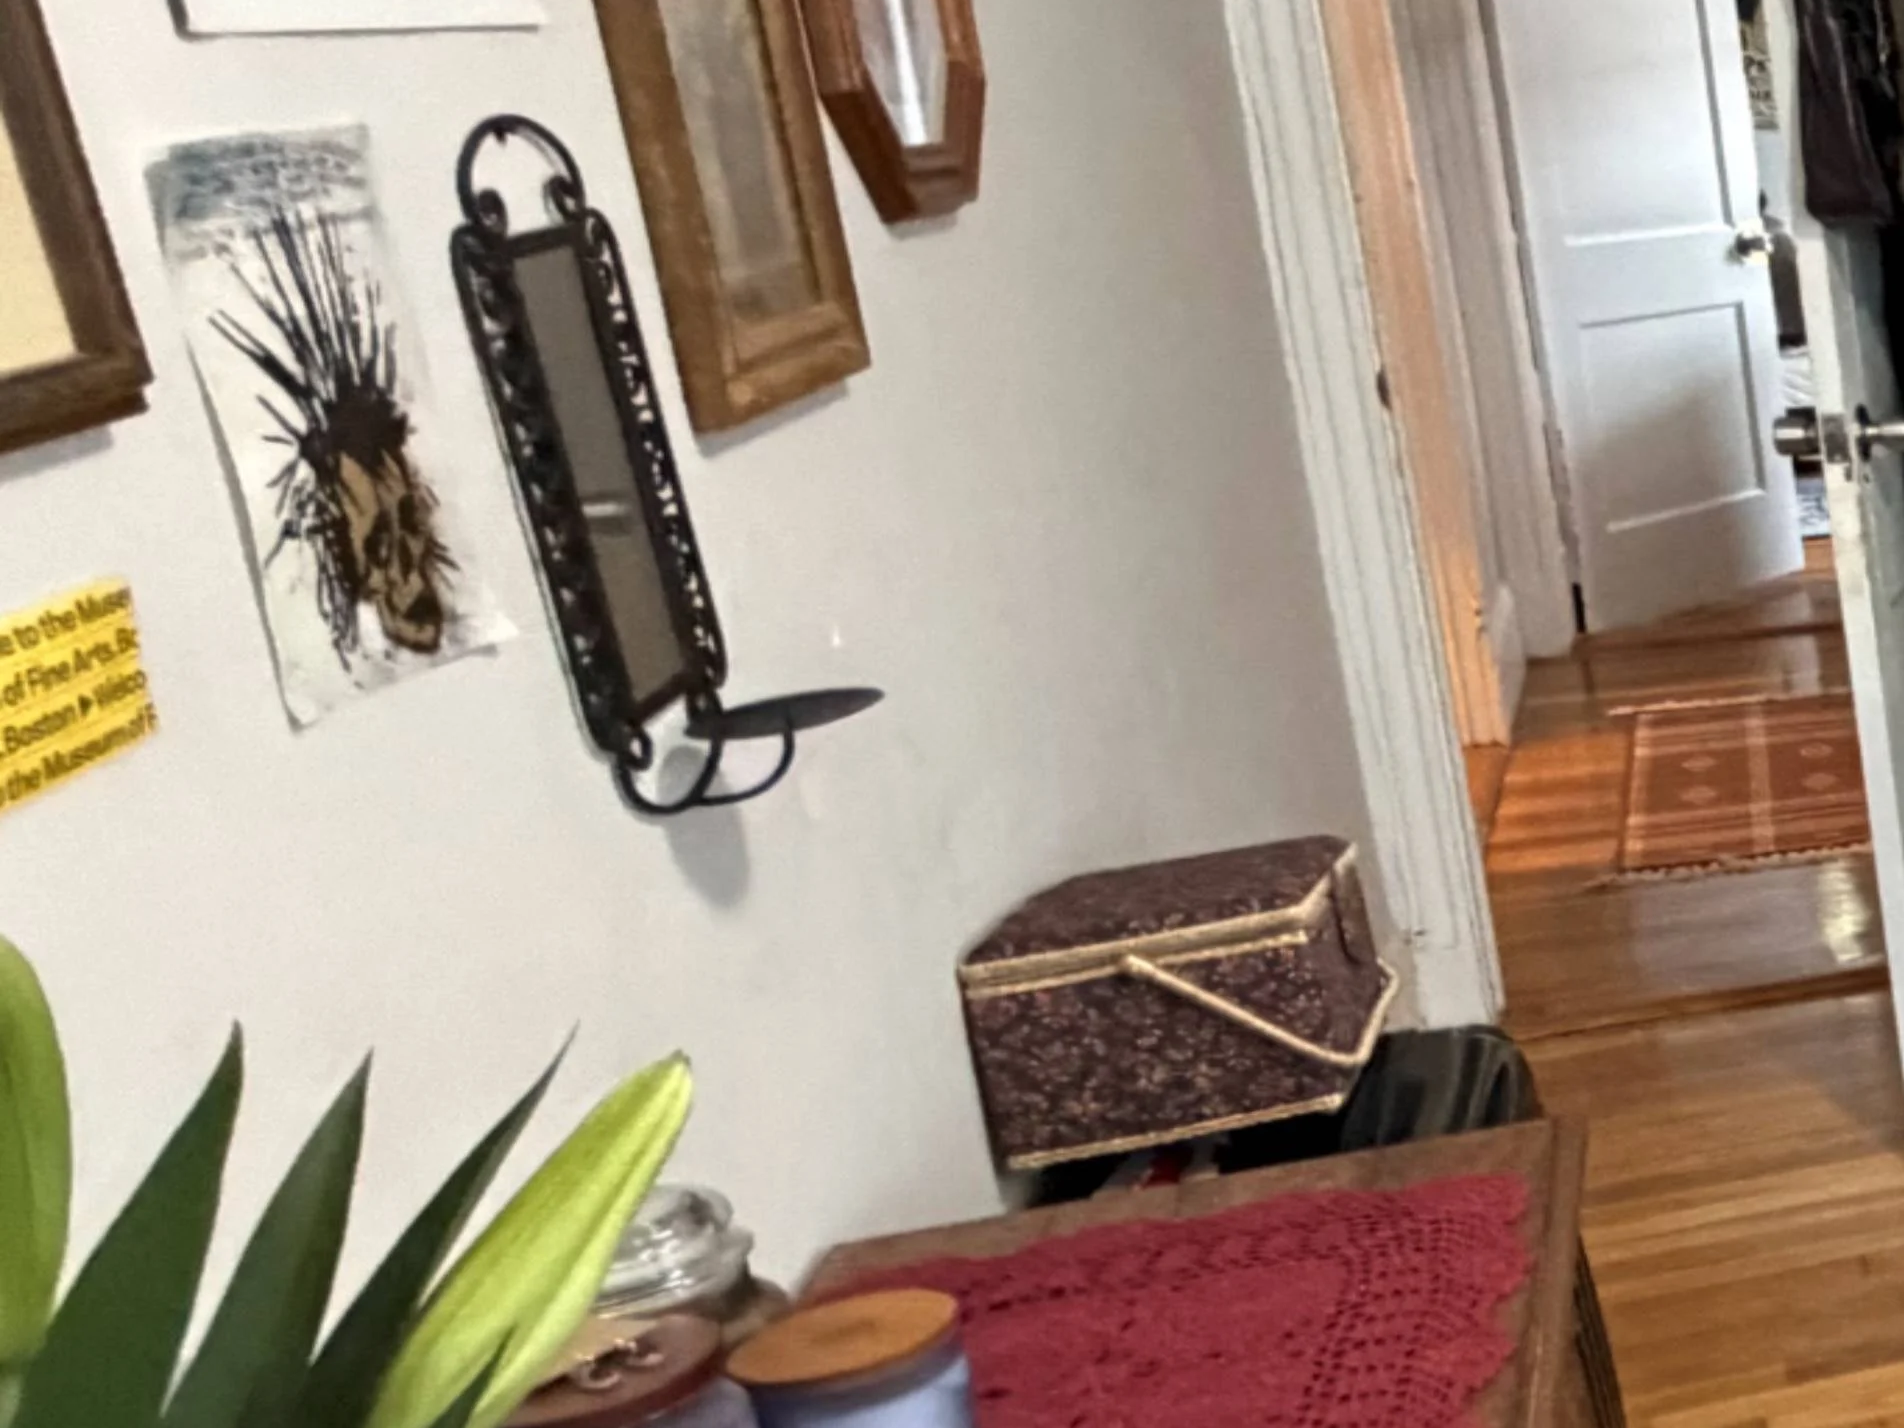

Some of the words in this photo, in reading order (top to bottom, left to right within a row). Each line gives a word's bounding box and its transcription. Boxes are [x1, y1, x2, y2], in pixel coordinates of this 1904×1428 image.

[12, 623, 41, 651] to
[38, 609, 77, 641] the
[3, 703, 77, 755] Boston
